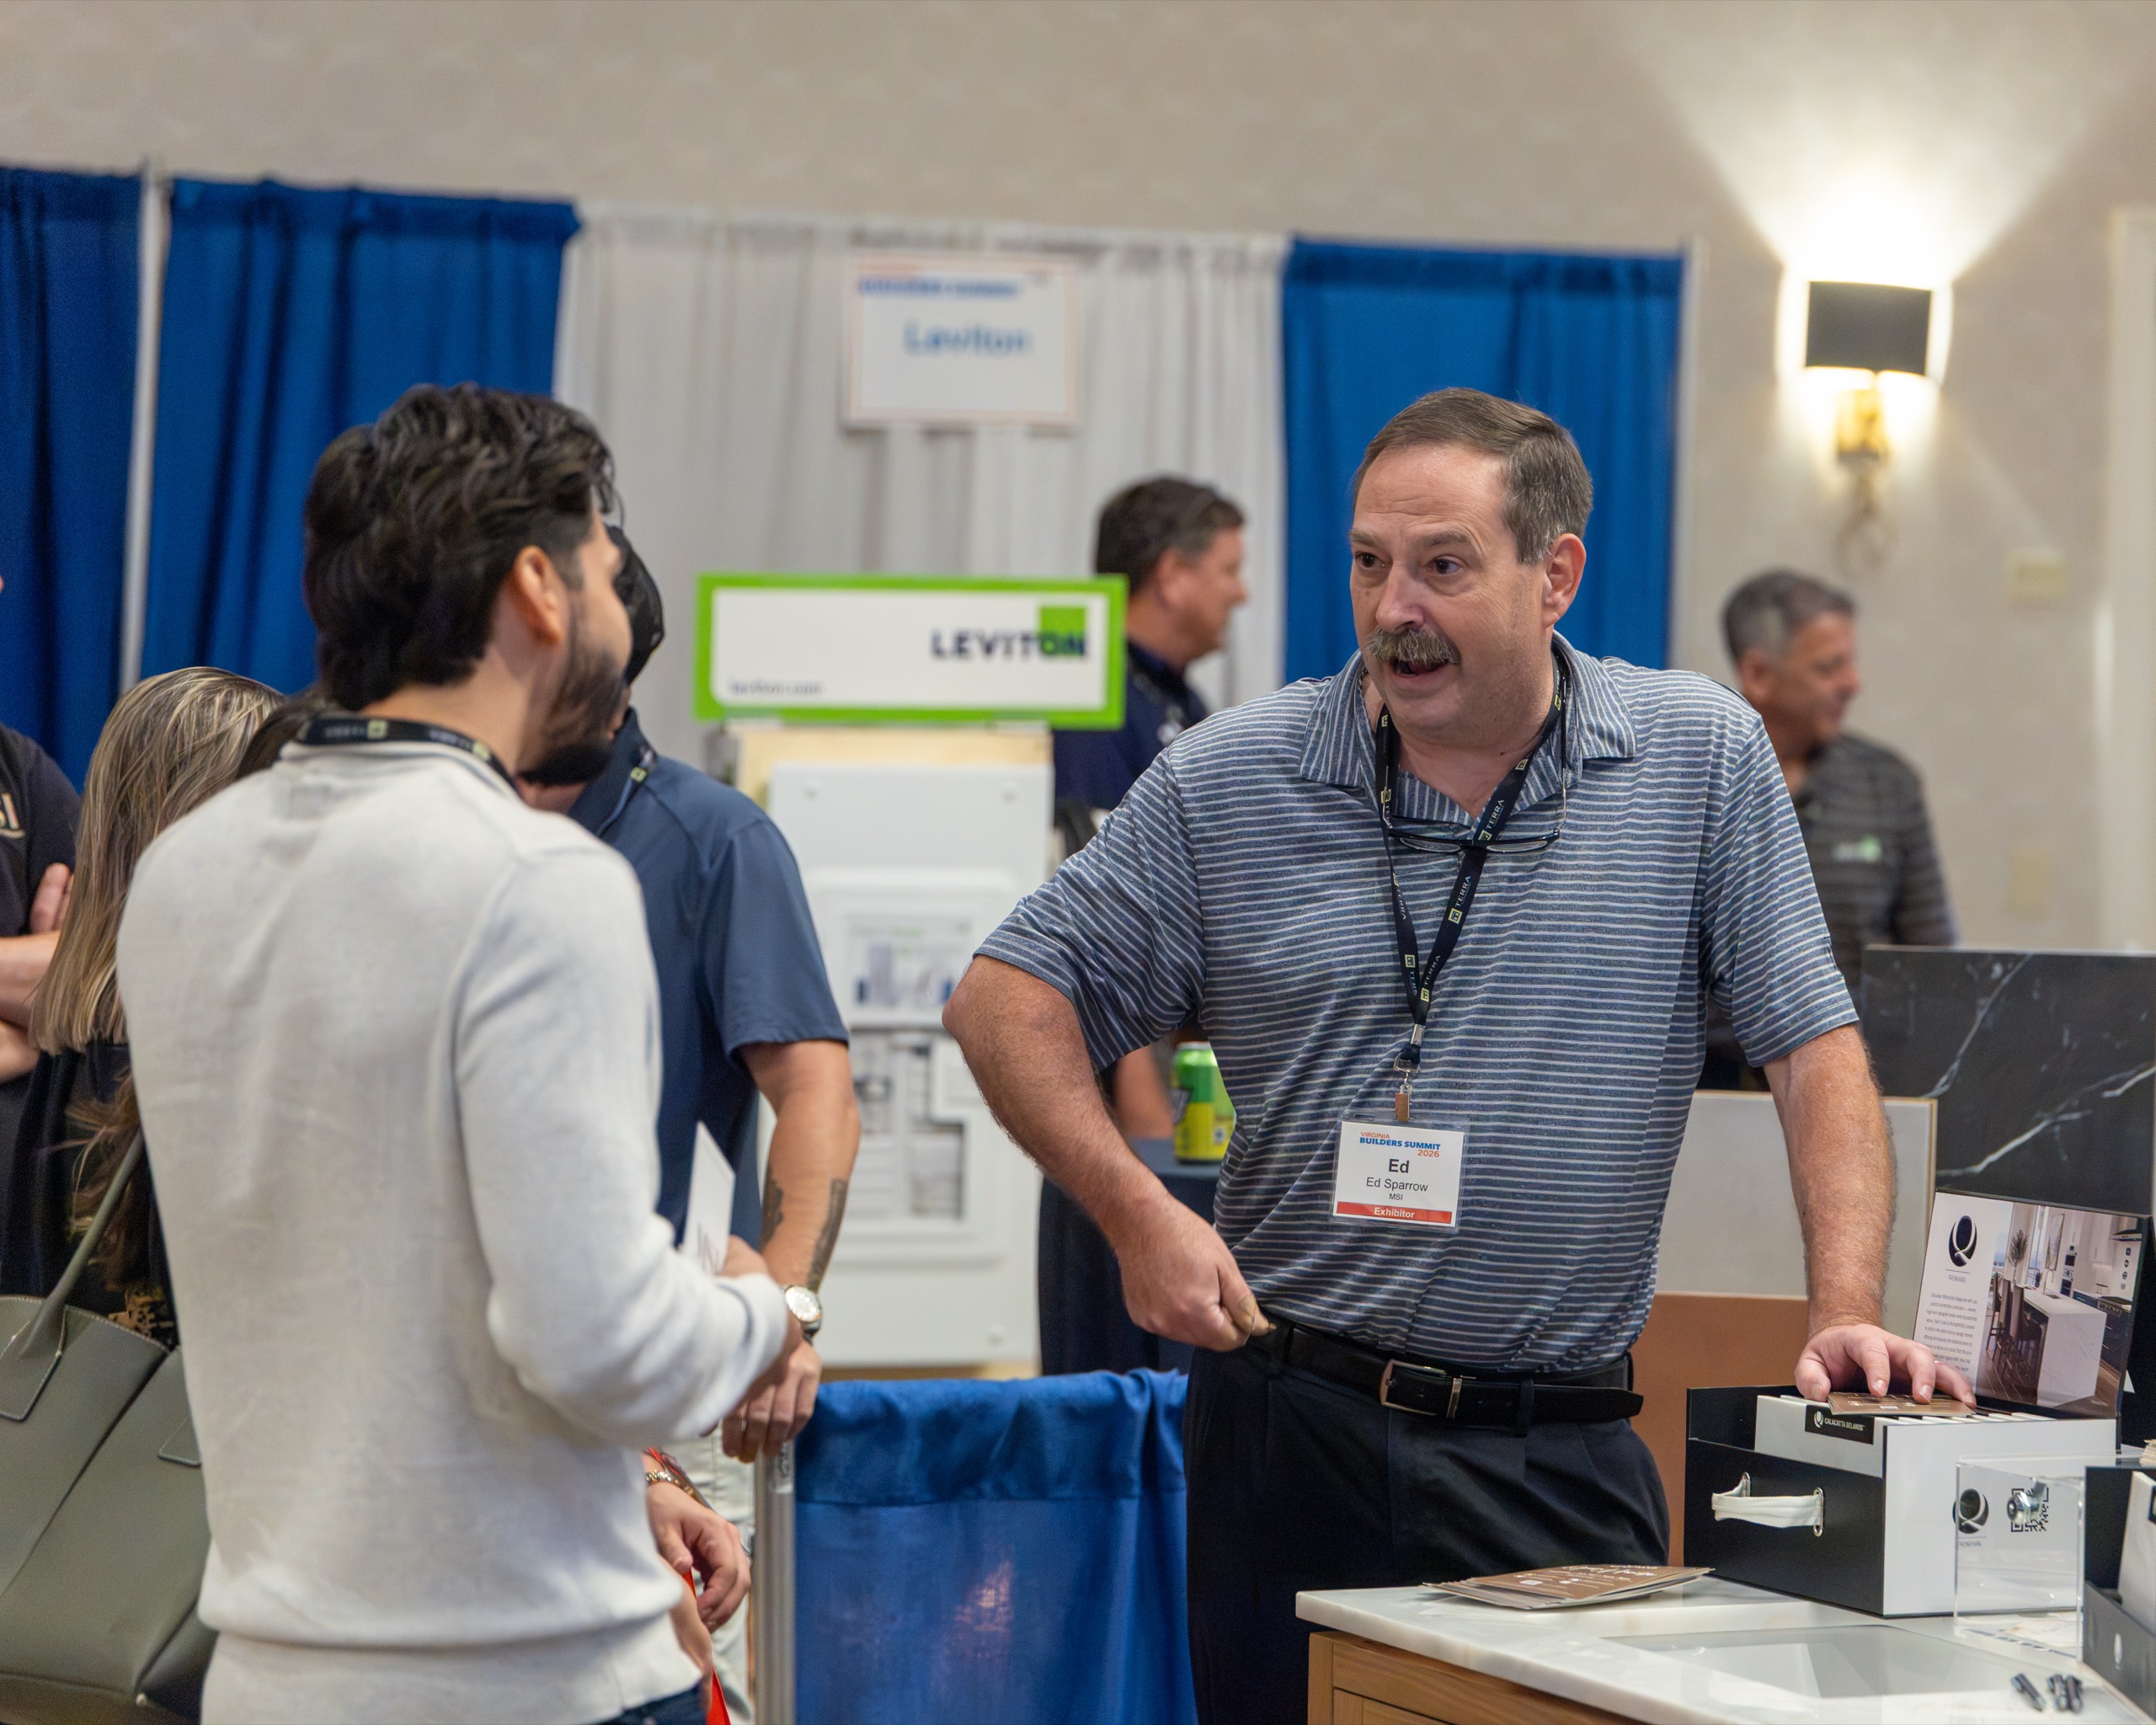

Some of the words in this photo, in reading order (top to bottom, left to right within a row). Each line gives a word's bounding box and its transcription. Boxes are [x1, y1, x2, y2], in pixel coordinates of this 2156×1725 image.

[931, 631, 1087, 659] LEVITON
[1486, 800, 1505, 830] TERRA
[1454, 876, 1471, 907] TERRA
[1359, 1137, 1402, 1147] BUILDERS
[1404, 1140, 1441, 1151] SUMMIT
[1417, 1149, 1440, 1158] 2026
[1388, 1158, 1410, 1173] Ed
[1366, 1177, 1381, 1188] Ed
[1384, 1178, 1428, 1192] Sparrow
[1389, 1193, 1403, 1201] MSI
[1374, 1207, 1416, 1219] Exhibitor
